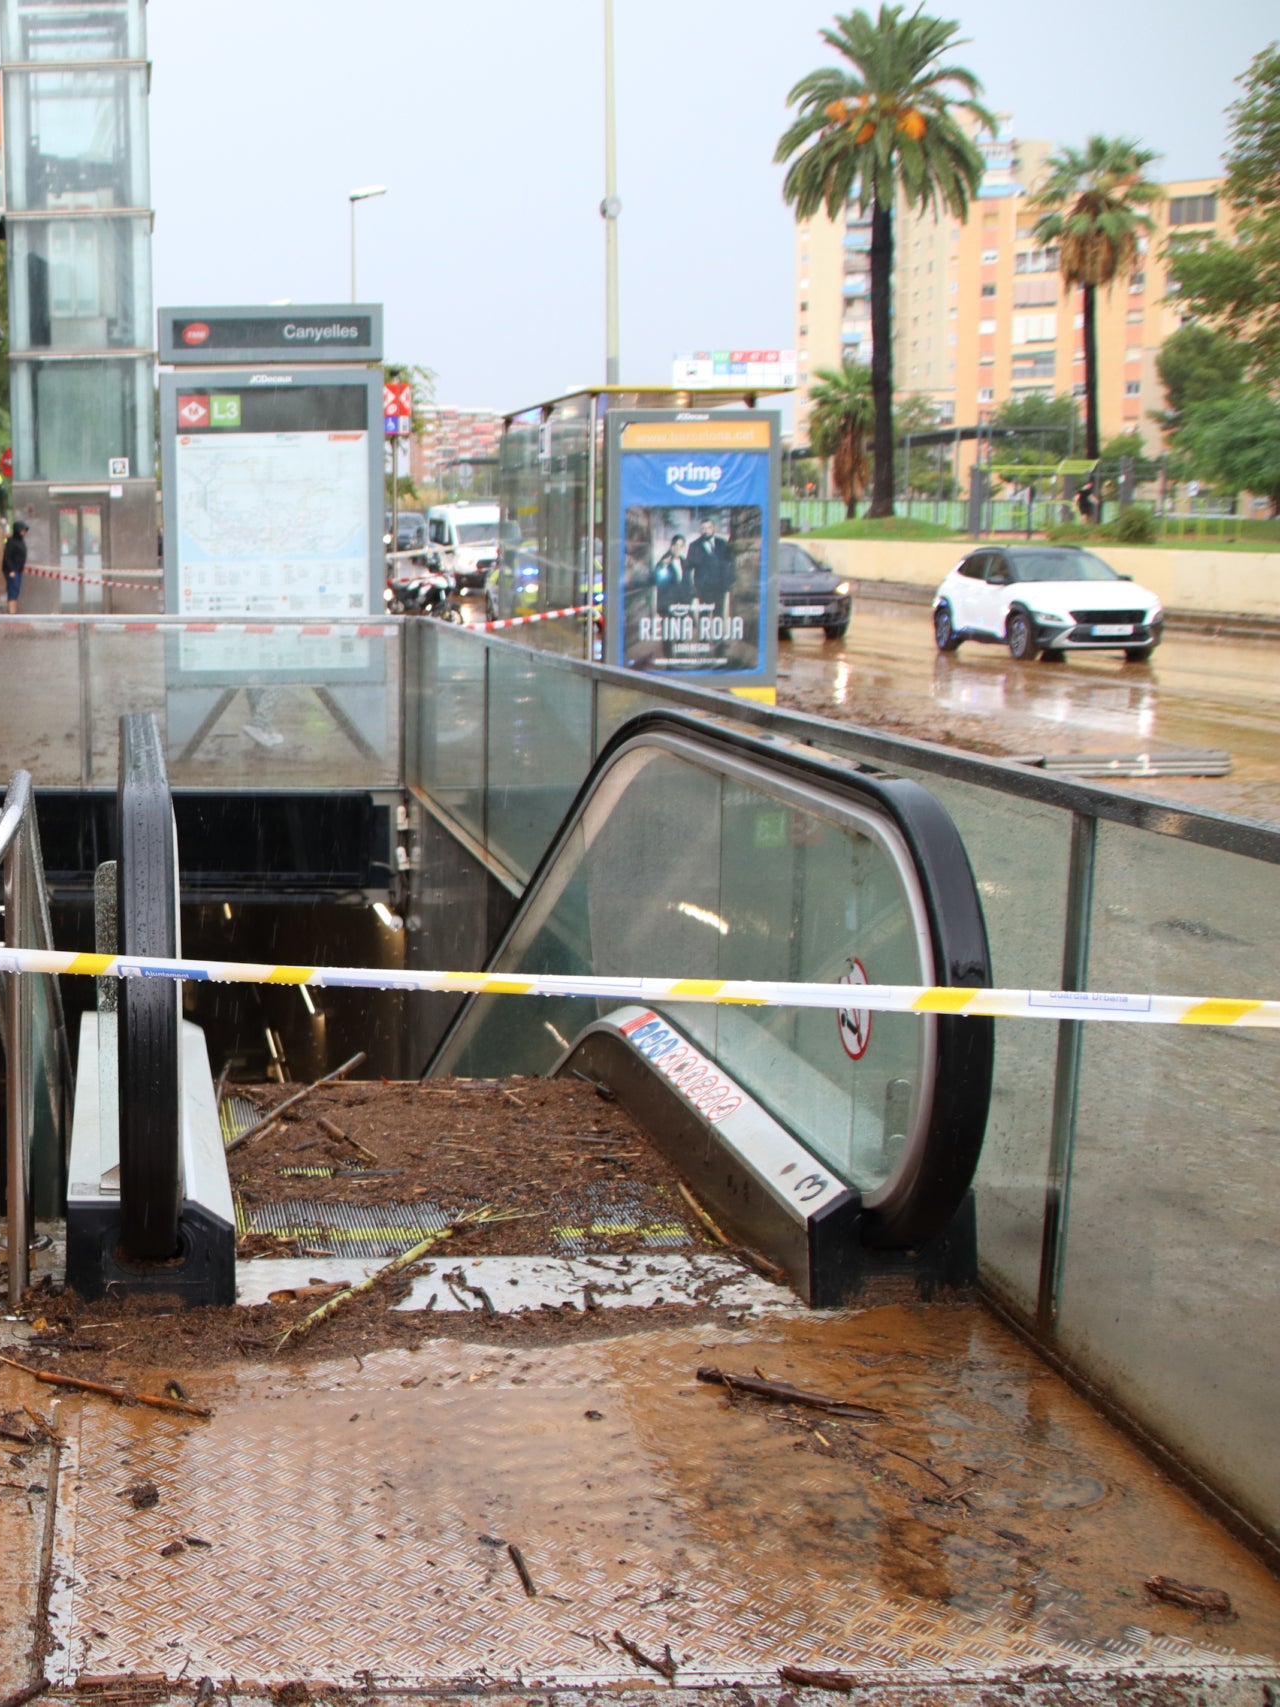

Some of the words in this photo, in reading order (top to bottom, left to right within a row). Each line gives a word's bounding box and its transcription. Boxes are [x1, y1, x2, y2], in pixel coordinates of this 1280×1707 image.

[283, 324, 359, 342] Canyelles
[189, 405, 200, 416] M
[213, 402, 239, 420] L3
[666, 462, 722, 485] prime
[640, 616, 693, 641] REINA
[699, 616, 744, 641] ROJA
